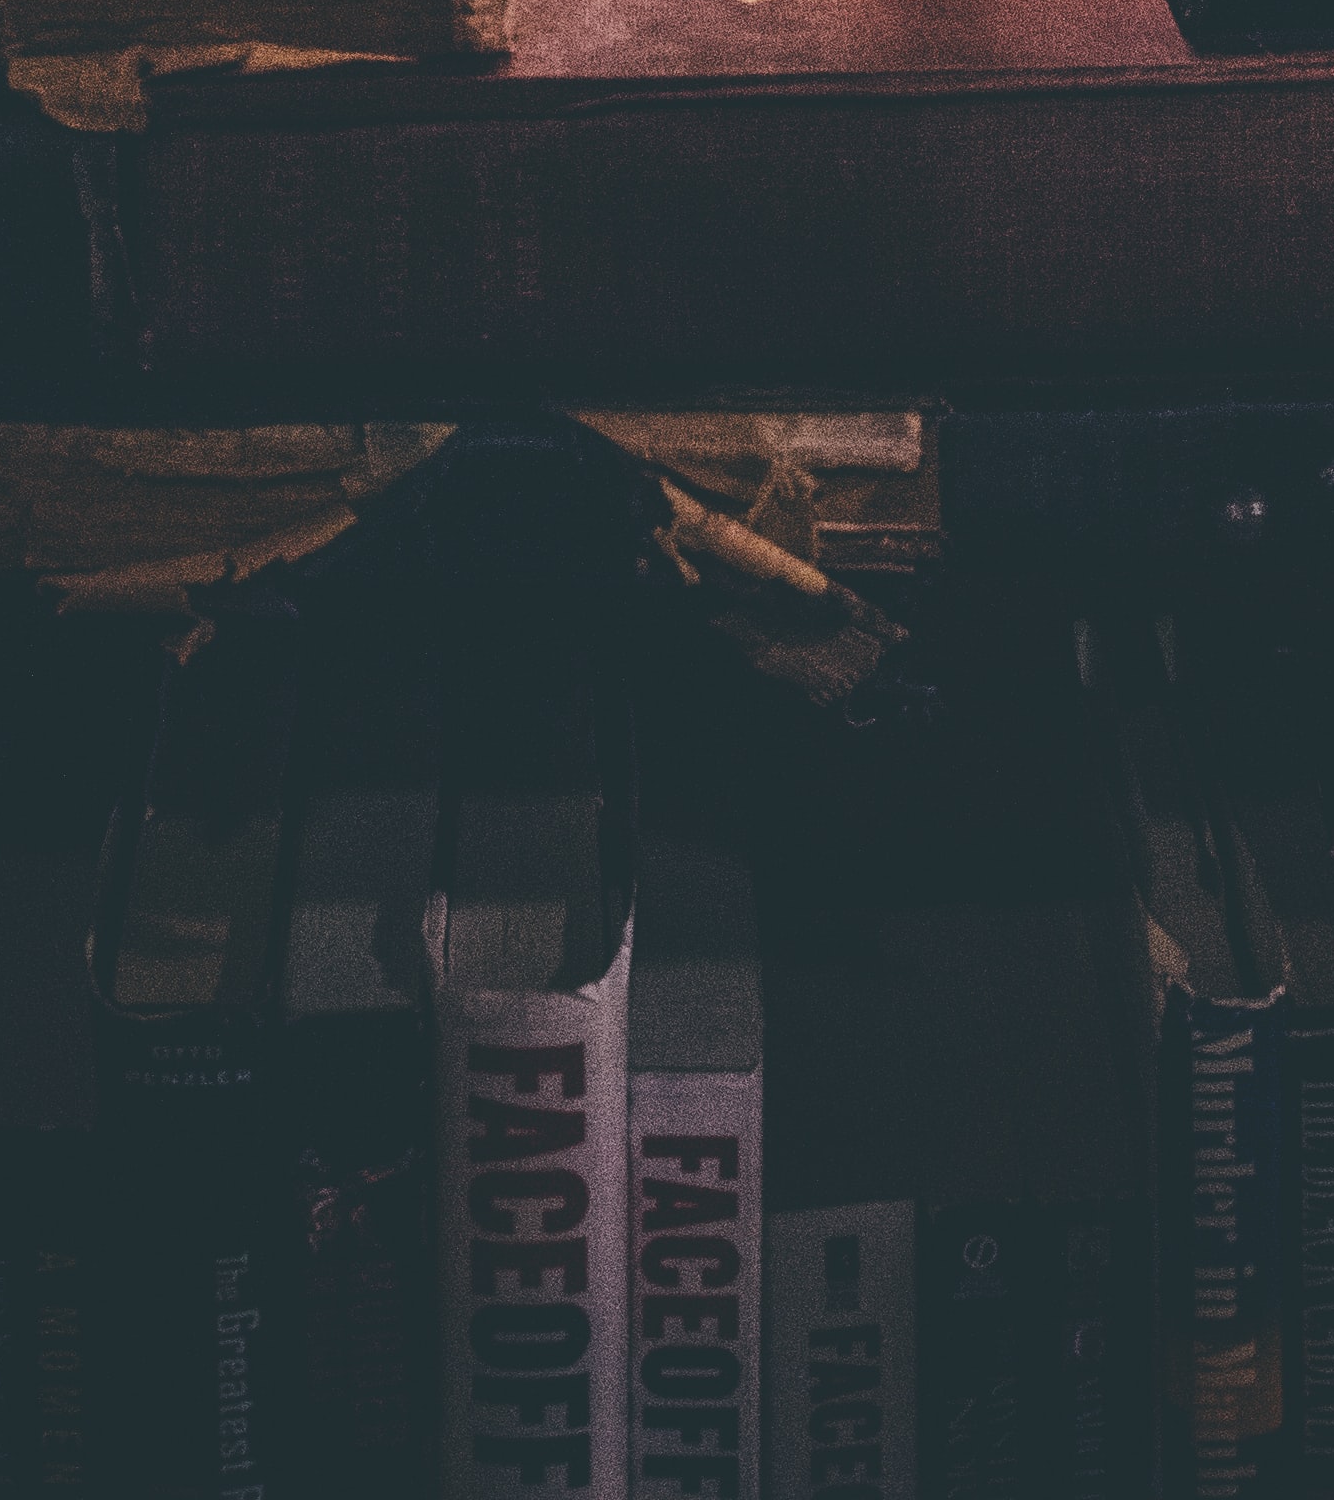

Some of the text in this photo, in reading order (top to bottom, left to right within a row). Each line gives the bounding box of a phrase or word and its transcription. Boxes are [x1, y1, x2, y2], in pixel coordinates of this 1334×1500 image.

[123, 1069, 254, 1090] PENZLER
[150, 1044, 224, 1063] OTTO
[1192, 1028, 1256, 1244] Murder
[213, 1251, 264, 1474] The Greatest
[466, 1041, 592, 1492] FACEOFF
[639, 1133, 743, 1500] FACEOFF
[1195, 1263, 1257, 1321] in
